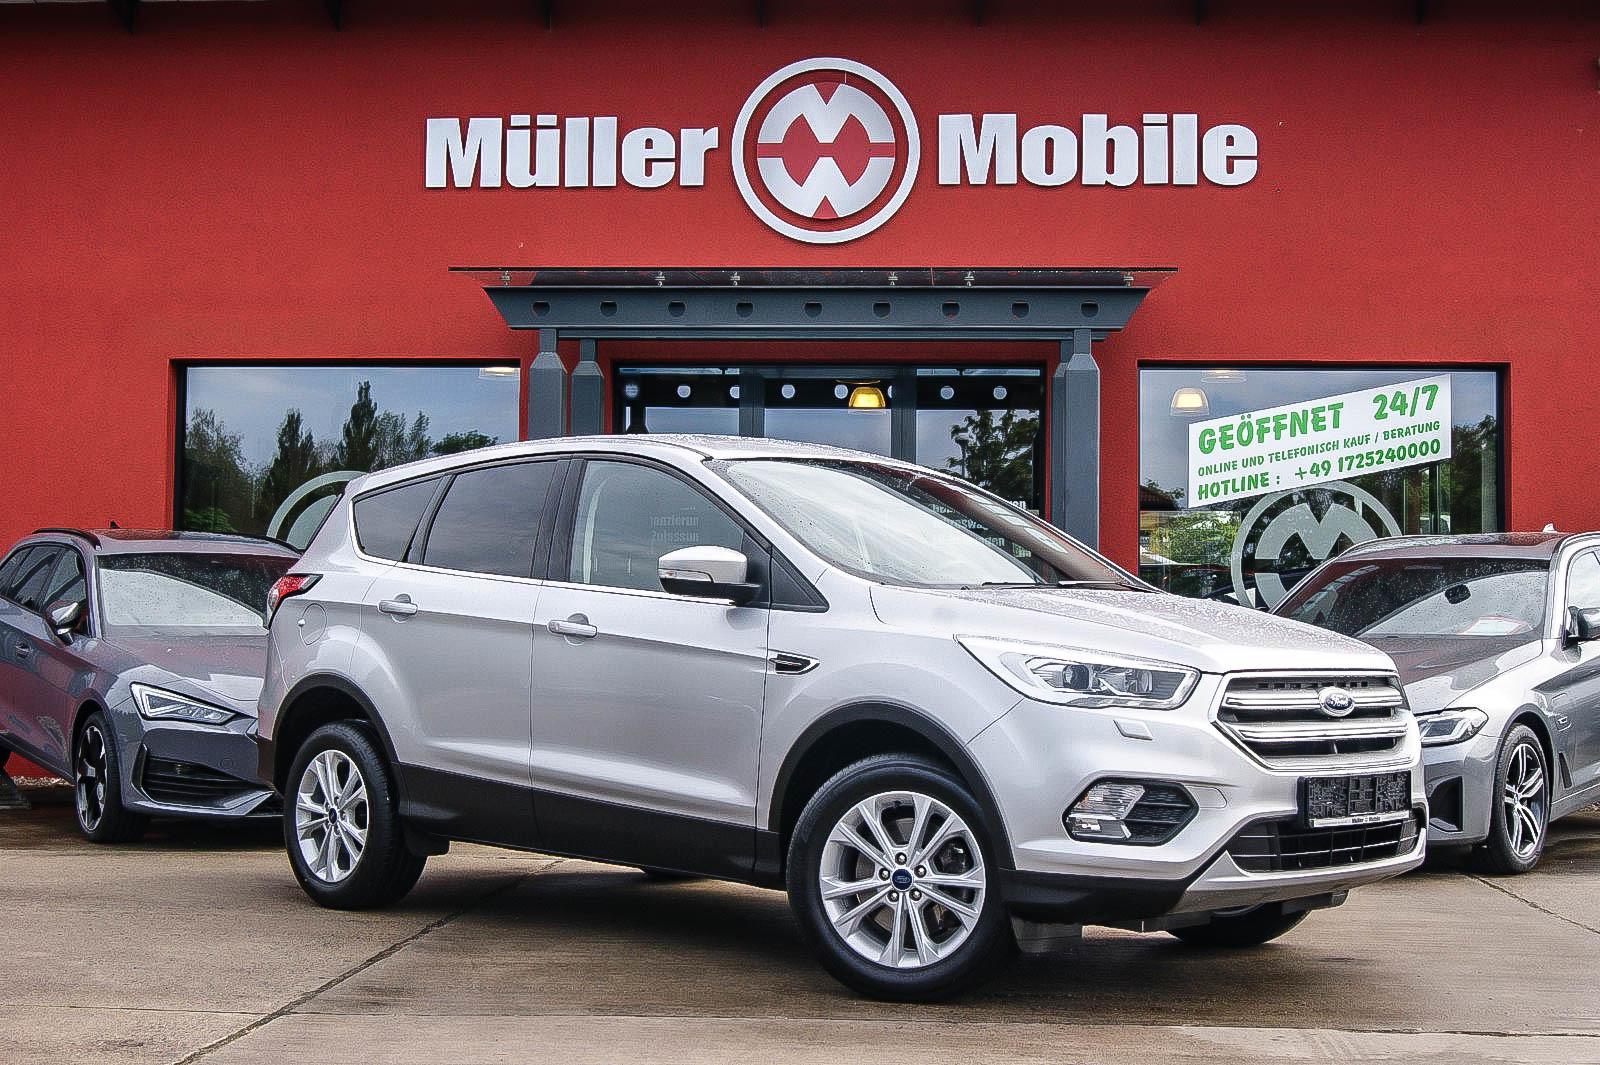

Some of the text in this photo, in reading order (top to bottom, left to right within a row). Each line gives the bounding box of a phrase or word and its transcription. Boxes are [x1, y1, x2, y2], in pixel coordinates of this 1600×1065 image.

[425, 113, 1259, 189] Müller Mobile
[1198, 460, 1238, 476] ONLINE
[1242, 455, 1264, 469] UND
[1268, 440, 1339, 463] TELEFONISCH
[1343, 434, 1370, 449] KAUF
[1383, 421, 1440, 440] BERATUNG
[1199, 384, 1439, 454] GEÖFFNET 24/7
[1198, 472, 1269, 500] HOTLINE
[1295, 460, 1331, 480] +49
[1338, 439, 1441, 473] 1725240000
